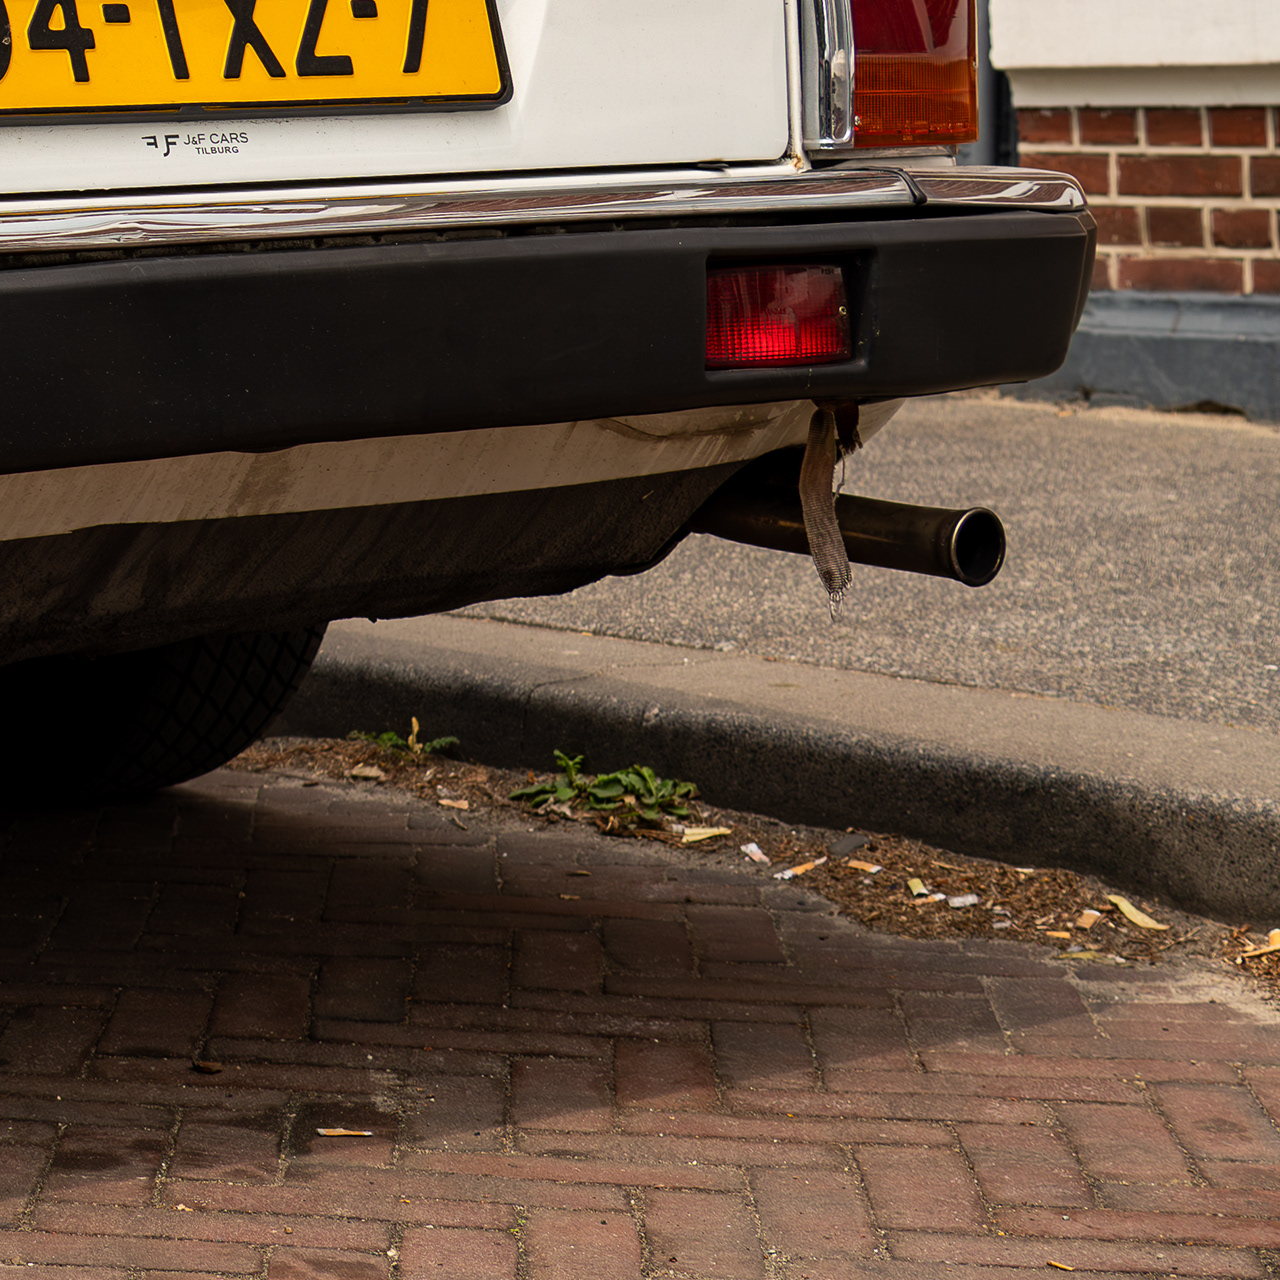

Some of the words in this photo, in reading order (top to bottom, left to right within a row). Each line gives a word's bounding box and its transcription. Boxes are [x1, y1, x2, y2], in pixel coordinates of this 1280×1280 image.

[183, 133, 206, 146] J&F
[209, 132, 249, 144] CARS
[195, 146, 239, 155] TILBURG
